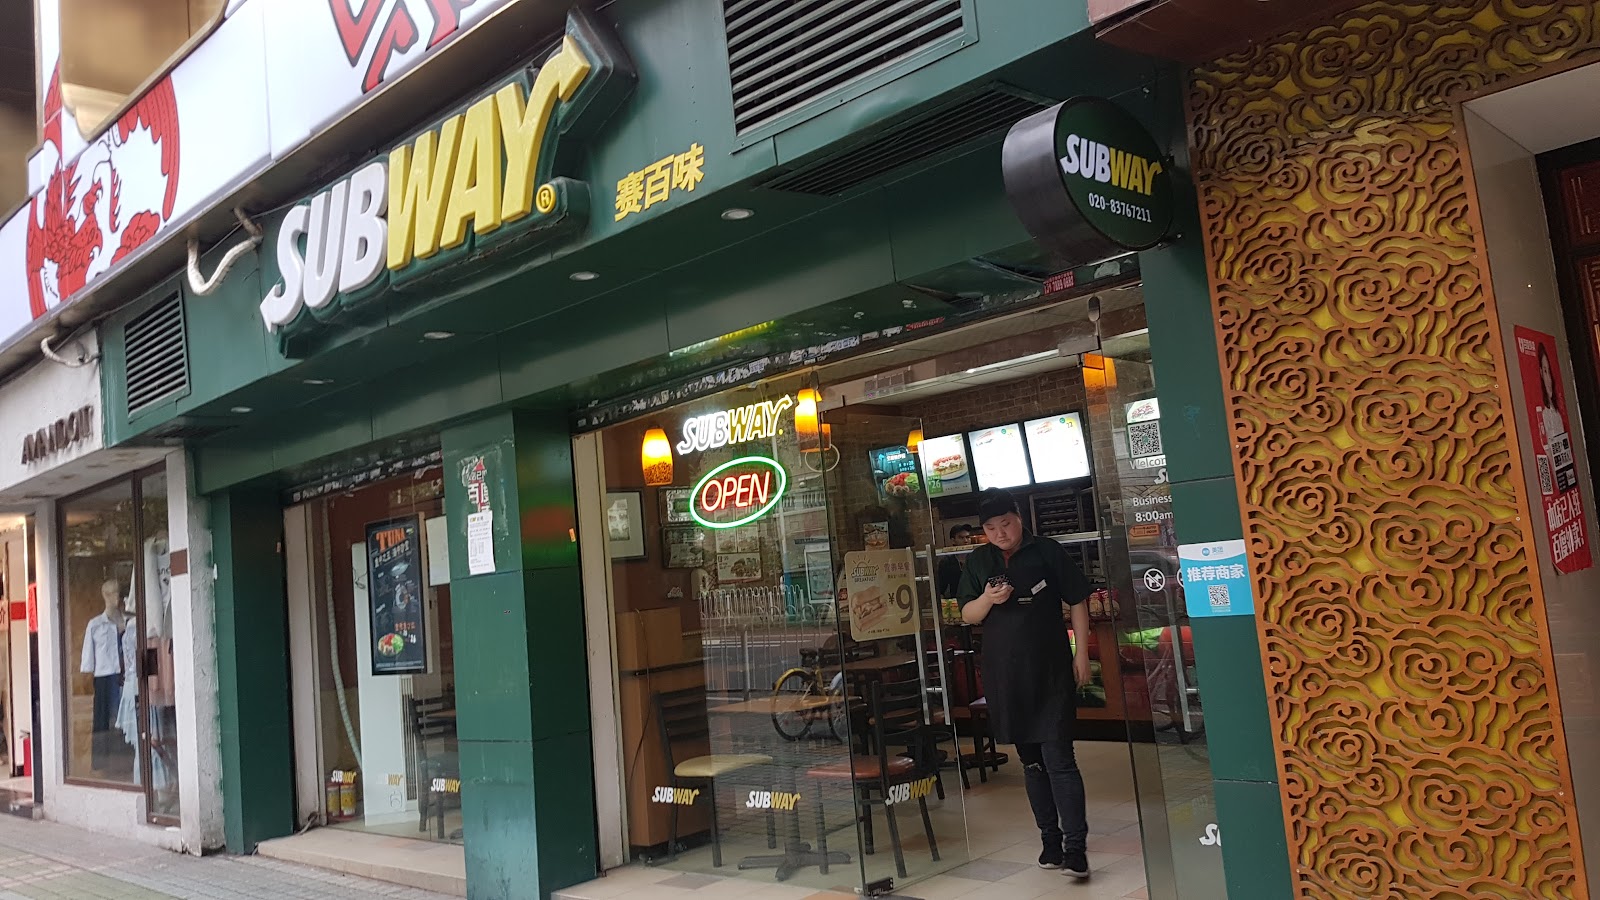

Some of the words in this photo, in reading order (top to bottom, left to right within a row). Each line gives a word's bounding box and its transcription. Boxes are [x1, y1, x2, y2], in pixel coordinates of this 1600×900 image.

[1060, 133, 1163, 196] SUBWAY
[260, 35, 590, 334] SUBWAY
[615, 142, 705, 222] 赛百味
[1088, 192, 1152, 223] 020-83767211
[676, 393, 793, 455] SUBWAY
[701, 470, 771, 512] OPEN
[1132, 495, 1173, 507] Business
[1135, 510, 1174, 523] 8:00am
[851, 565, 880, 577] SUBWAY
[1186, 563, 1246, 583] 推荐商家
[331, 770, 357, 784] SUBWAY
[430, 778, 460, 793] SUBWAY
[652, 786, 700, 806] SUBWAY
[745, 790, 802, 811] SUBWAY
[885, 775, 937, 806] SUBWAY
[1199, 823, 1221, 847] S
